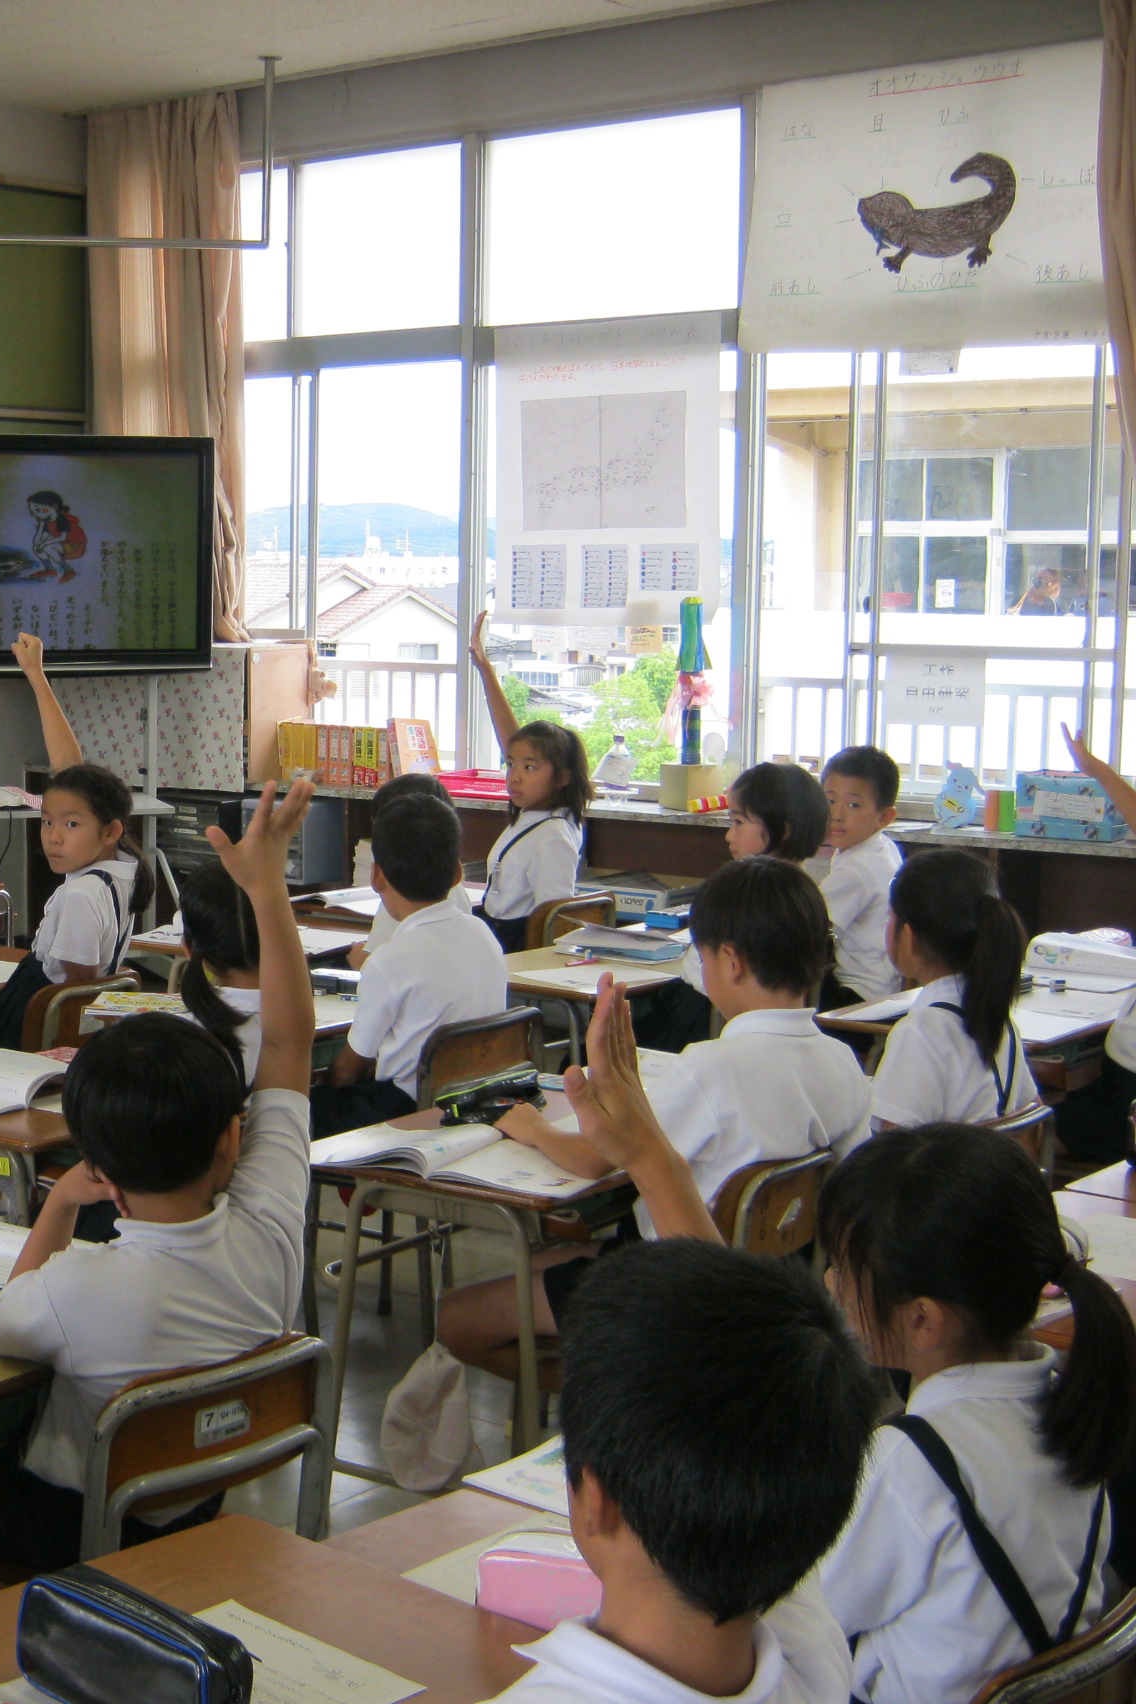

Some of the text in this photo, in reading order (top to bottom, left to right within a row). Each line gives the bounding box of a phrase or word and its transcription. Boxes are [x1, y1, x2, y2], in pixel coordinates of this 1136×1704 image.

[783, 121, 816, 139] はな
[923, 663, 956, 677] 工作
[204, 1411, 215, 1428] 7
